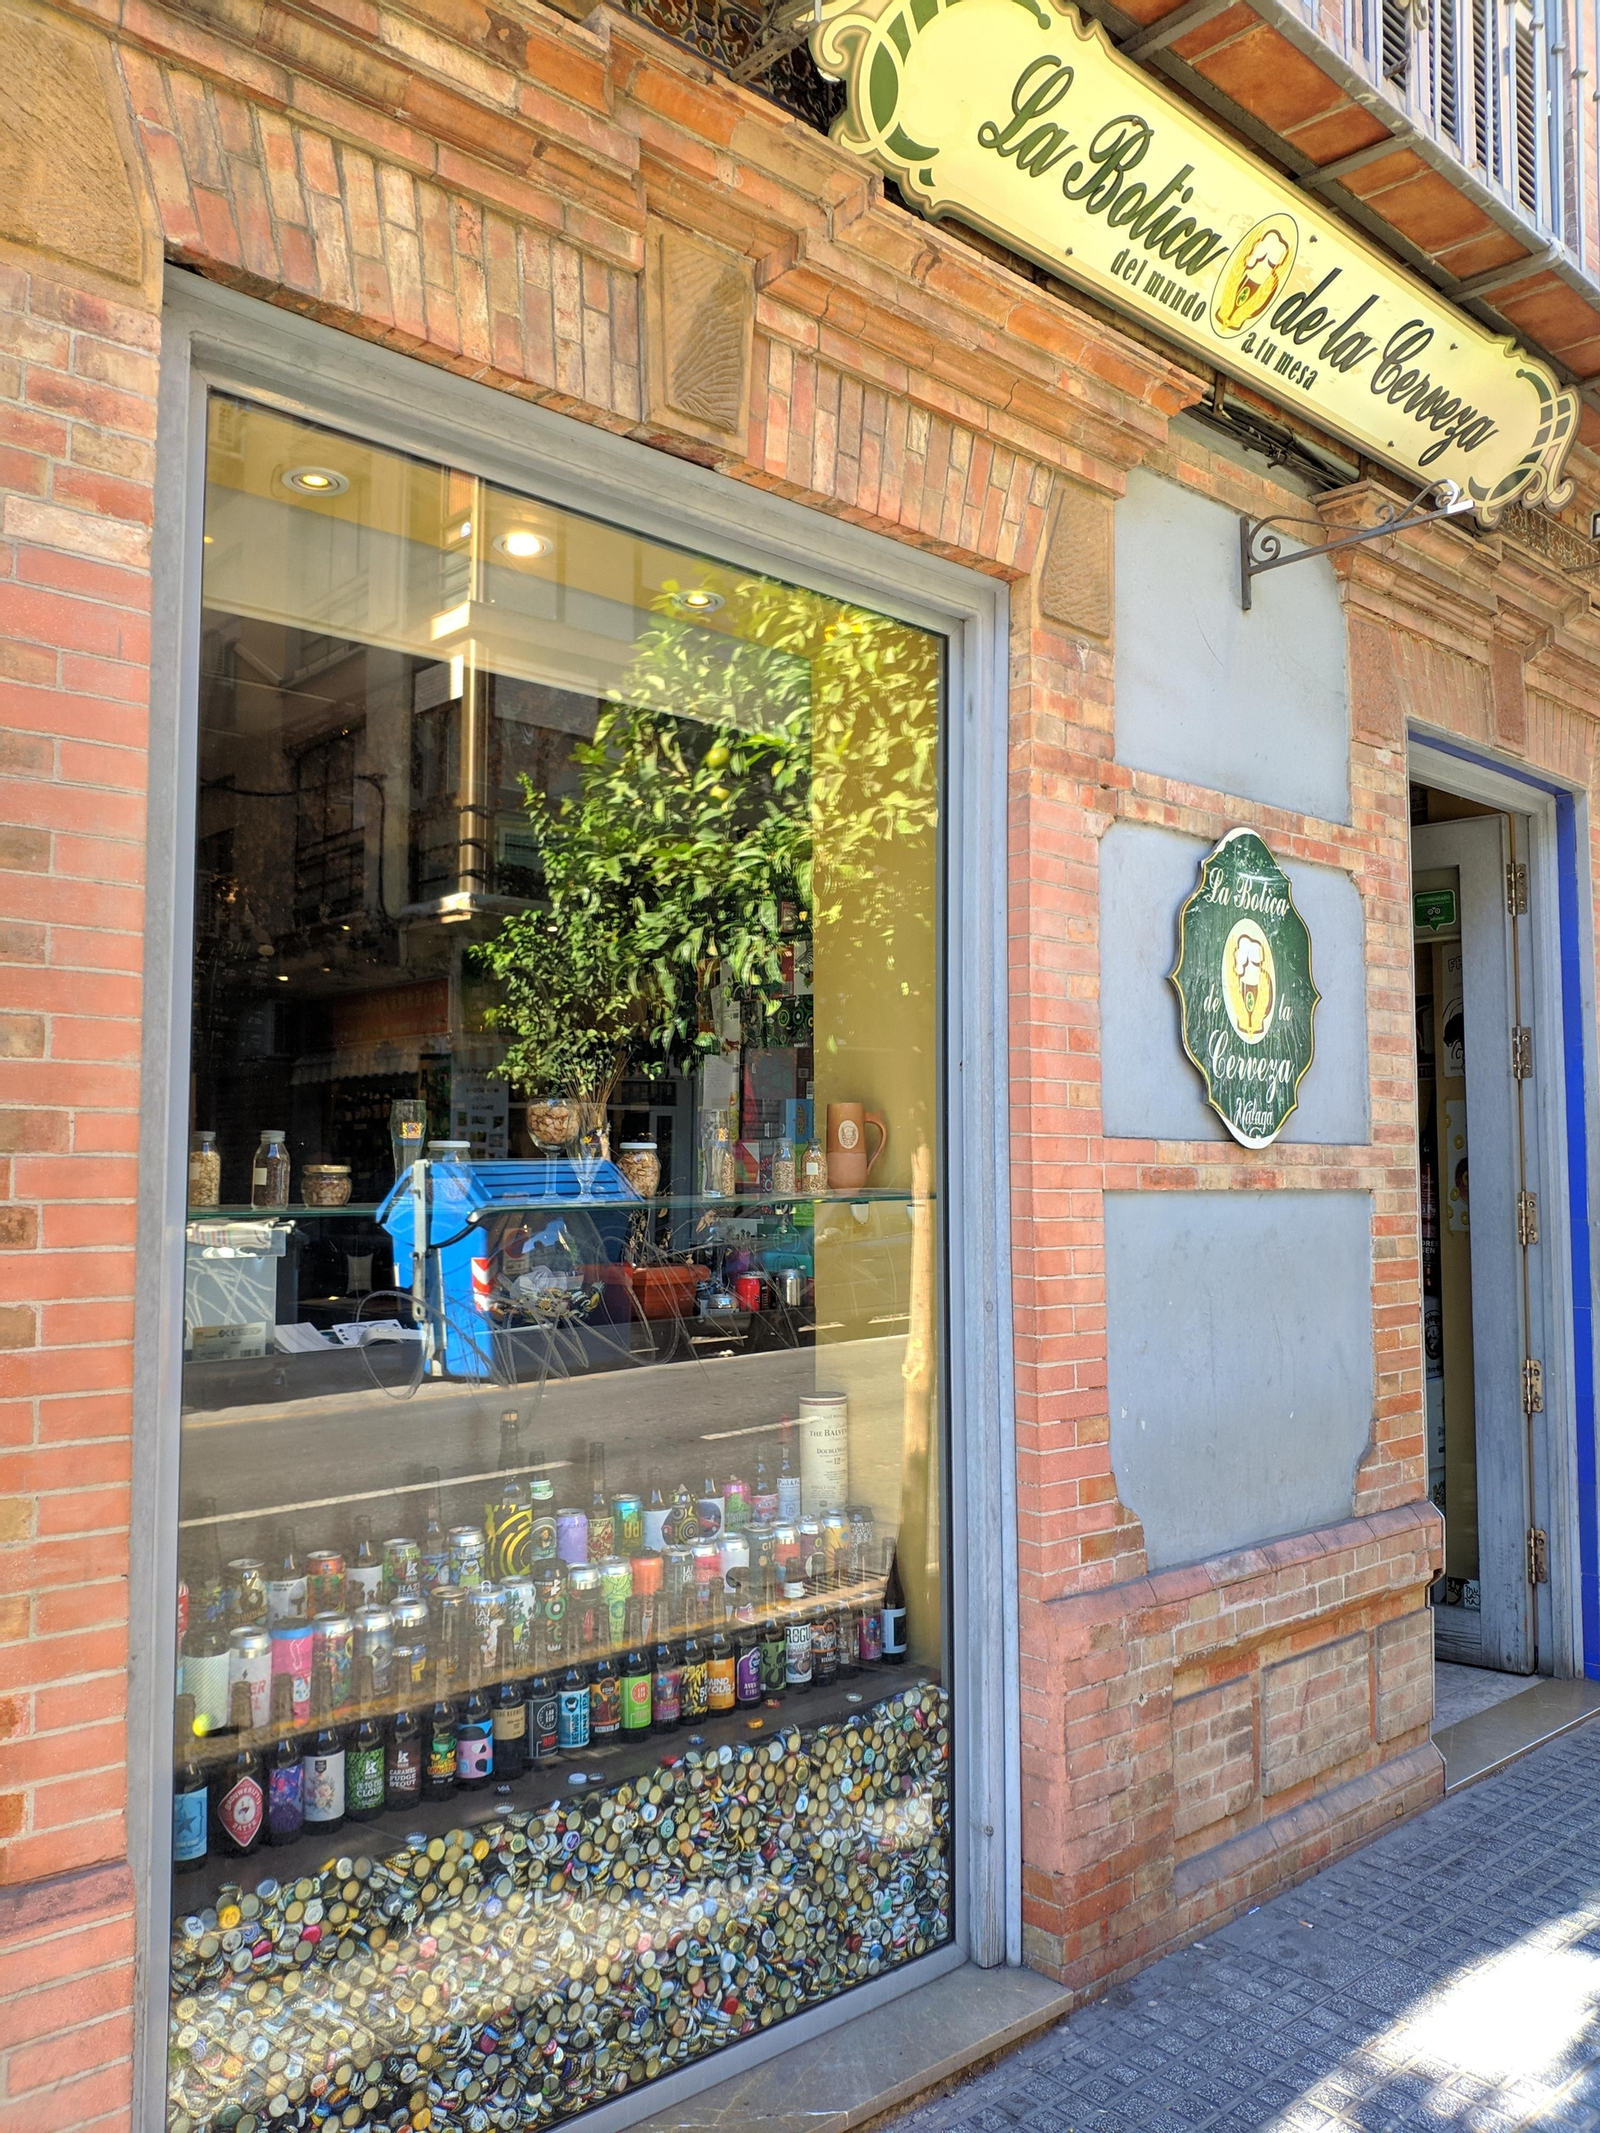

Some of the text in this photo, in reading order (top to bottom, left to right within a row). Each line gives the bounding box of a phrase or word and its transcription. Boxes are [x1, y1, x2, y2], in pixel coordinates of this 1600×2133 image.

[978, 54, 1230, 276] La Botica
[1110, 248, 1207, 322] del mundo
[1241, 331, 1319, 391] a tu mesa
[1270, 267, 1499, 466] de la Cerveza
[1203, 867, 1291, 917] La Botica
[1203, 983, 1294, 1021] de la
[1208, 1029, 1295, 1103] Cerveza
